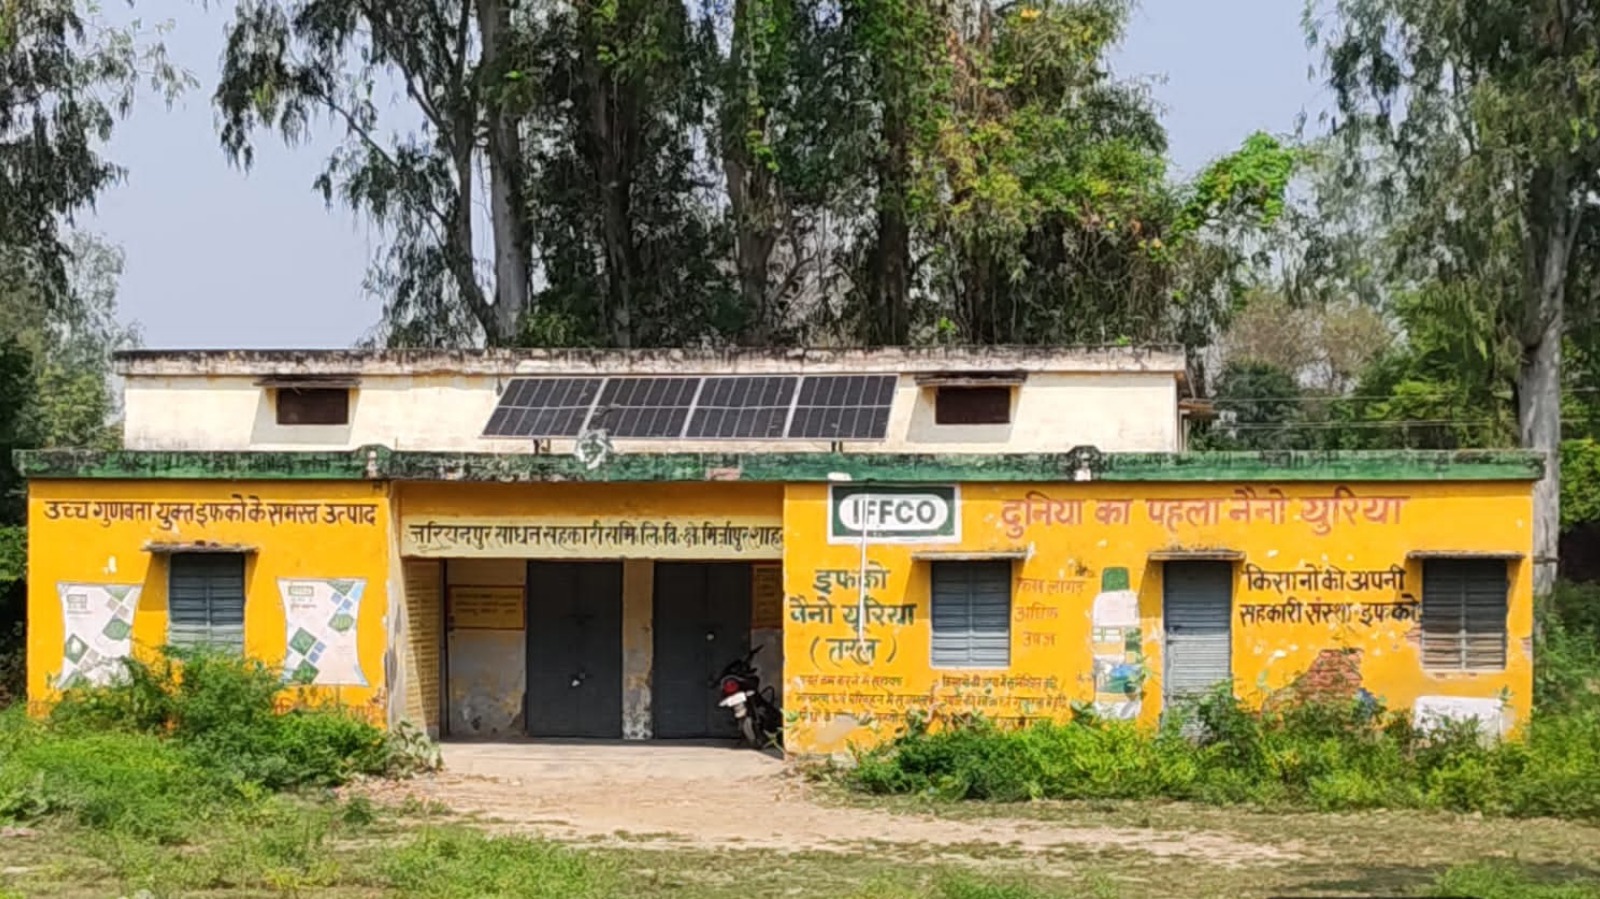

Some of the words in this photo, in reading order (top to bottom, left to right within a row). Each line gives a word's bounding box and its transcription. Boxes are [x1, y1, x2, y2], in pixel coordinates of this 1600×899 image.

[44, 500, 91, 520] उच्च
[156, 501, 196, 531] युक्त
[195, 493, 248, 528] इफको
[247, 494, 267, 523] के
[267, 503, 321, 526] समस्त
[322, 503, 379, 526] उत्पाद
[852, 498, 937, 526] IFFCO
[1001, 490, 1085, 540] दुनिया
[1093, 498, 1134, 525] का
[1145, 497, 1223, 533] पहला
[1228, 485, 1290, 525] नैनो
[494, 524, 543, 547] साधन
[543, 520, 604, 550] सहकारी
[812, 559, 891, 595] इफको
[1241, 564, 1323, 594] किसानों
[1346, 564, 1407, 592] अपनी
[788, 594, 837, 625] नैनो
[1240, 596, 1302, 627] सहकारी
